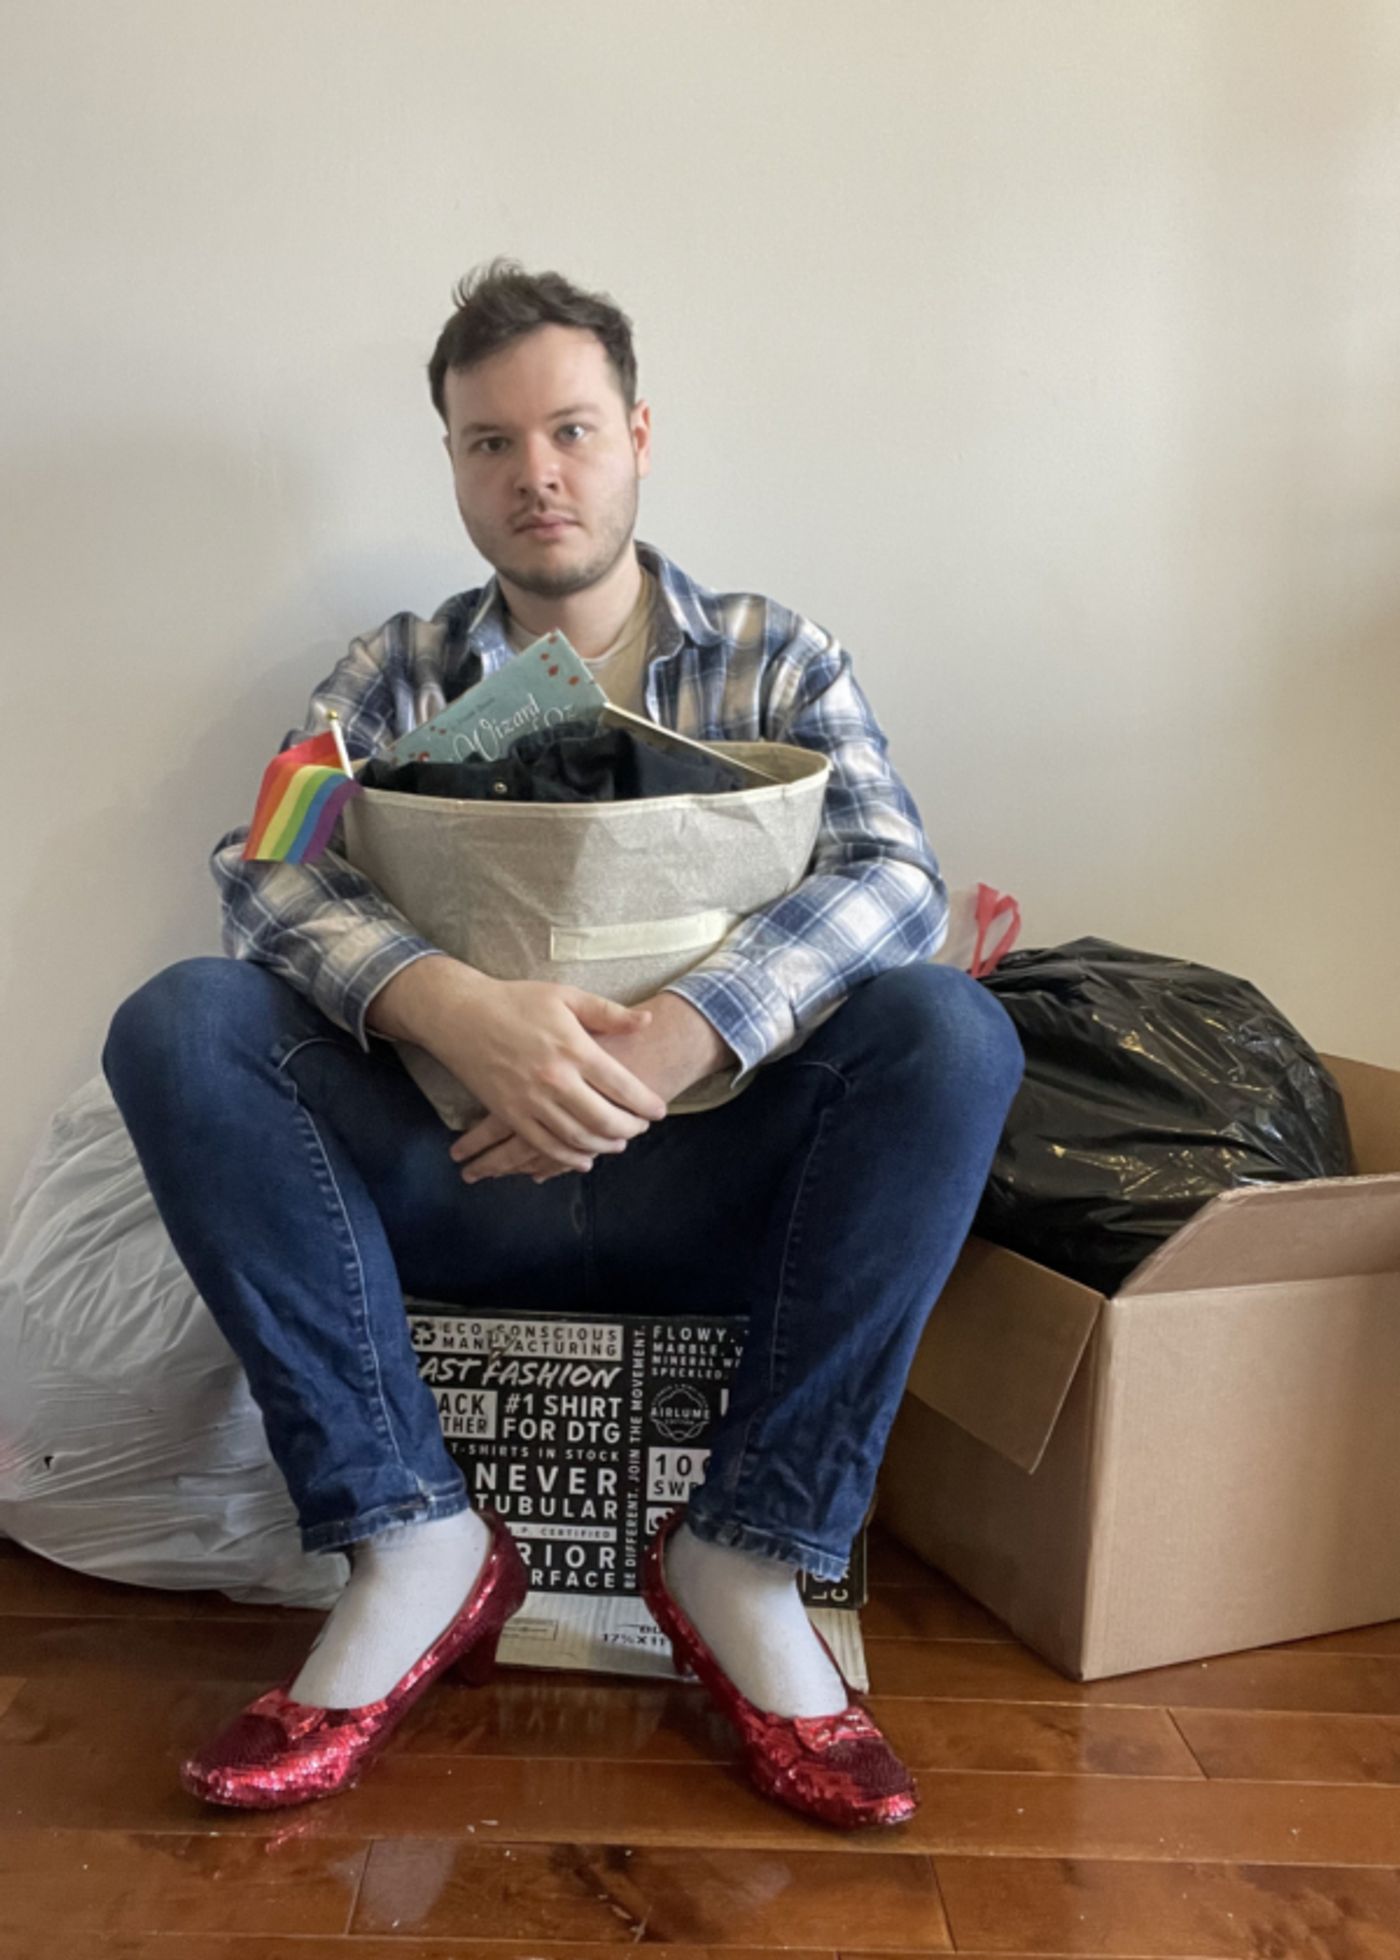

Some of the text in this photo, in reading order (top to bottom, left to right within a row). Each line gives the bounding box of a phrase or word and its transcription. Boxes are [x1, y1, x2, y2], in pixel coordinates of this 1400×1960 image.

[452, 693, 541, 762] Wizard
[419, 1357, 624, 1389] AST FASHION
[630, 1325, 646, 1411] MOVEMENT.
[438, 1392, 486, 1415] ACK
[504, 1393, 623, 1419] #1 SHIRT
[442, 1416, 487, 1434] THER
[502, 1417, 621, 1444] FOR DTG
[629, 1415, 643, 1443] THE
[538, 1447, 556, 1460] IN
[565, 1449, 620, 1462] STOCK
[627, 1448, 641, 1483] JOIN
[475, 1462, 619, 1496] NEVER
[475, 1493, 618, 1520] TUBULAR
[540, 1528, 611, 1539] CERTIFIED
[514, 1541, 617, 1570] RIOR
[531, 1569, 616, 1588] RFACE
